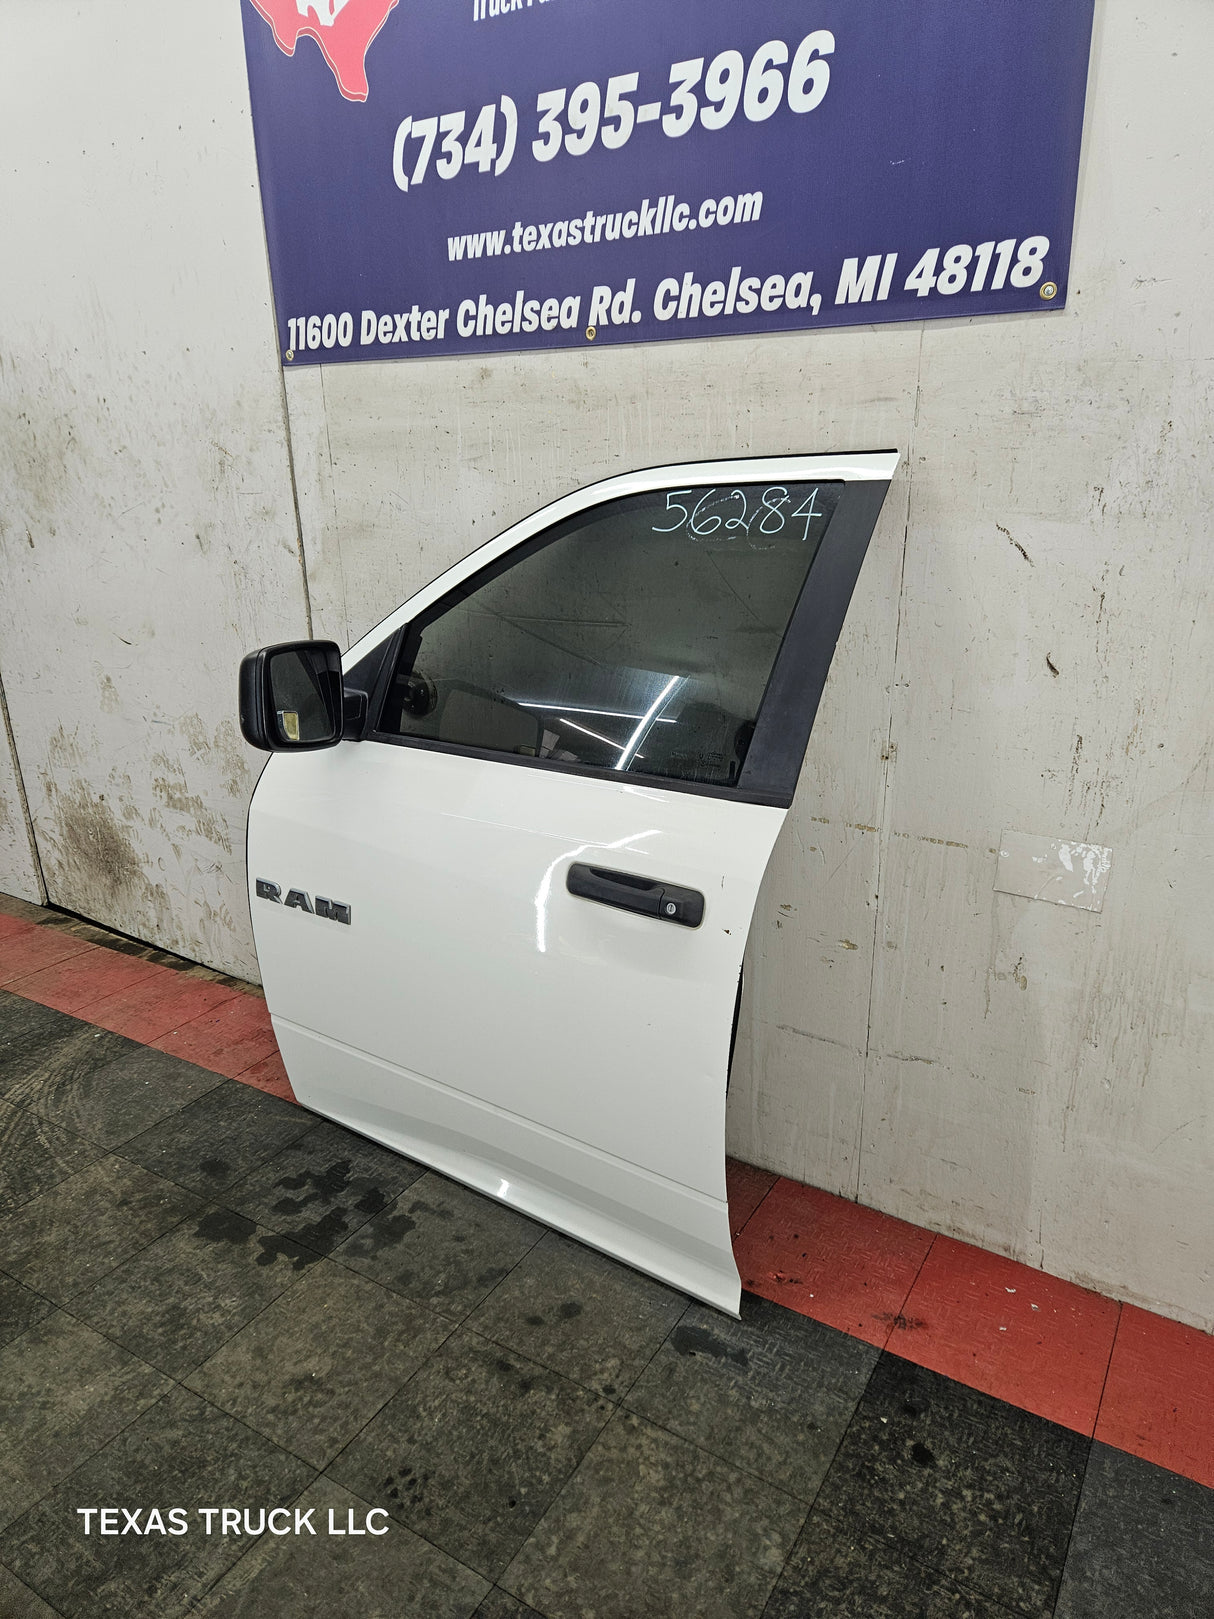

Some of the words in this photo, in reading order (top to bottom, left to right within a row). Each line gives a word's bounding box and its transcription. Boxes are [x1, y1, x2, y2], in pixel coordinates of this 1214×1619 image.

[392, 95, 518, 193] (734)
[532, 30, 836, 163] 395-3966
[447, 191, 764, 262] www.texastruckllc.com
[287, 312, 354, 351] 11600
[360, 305, 450, 346] Dexter
[456, 290, 581, 338] Chelsea
[588, 278, 642, 327] Rd.
[653, 266, 823, 321] Chelsea,
[834, 252, 899, 305] MI
[903, 236, 1050, 297] 48118
[651, 486, 823, 541] 56284
[255, 877, 352, 926] RAM
